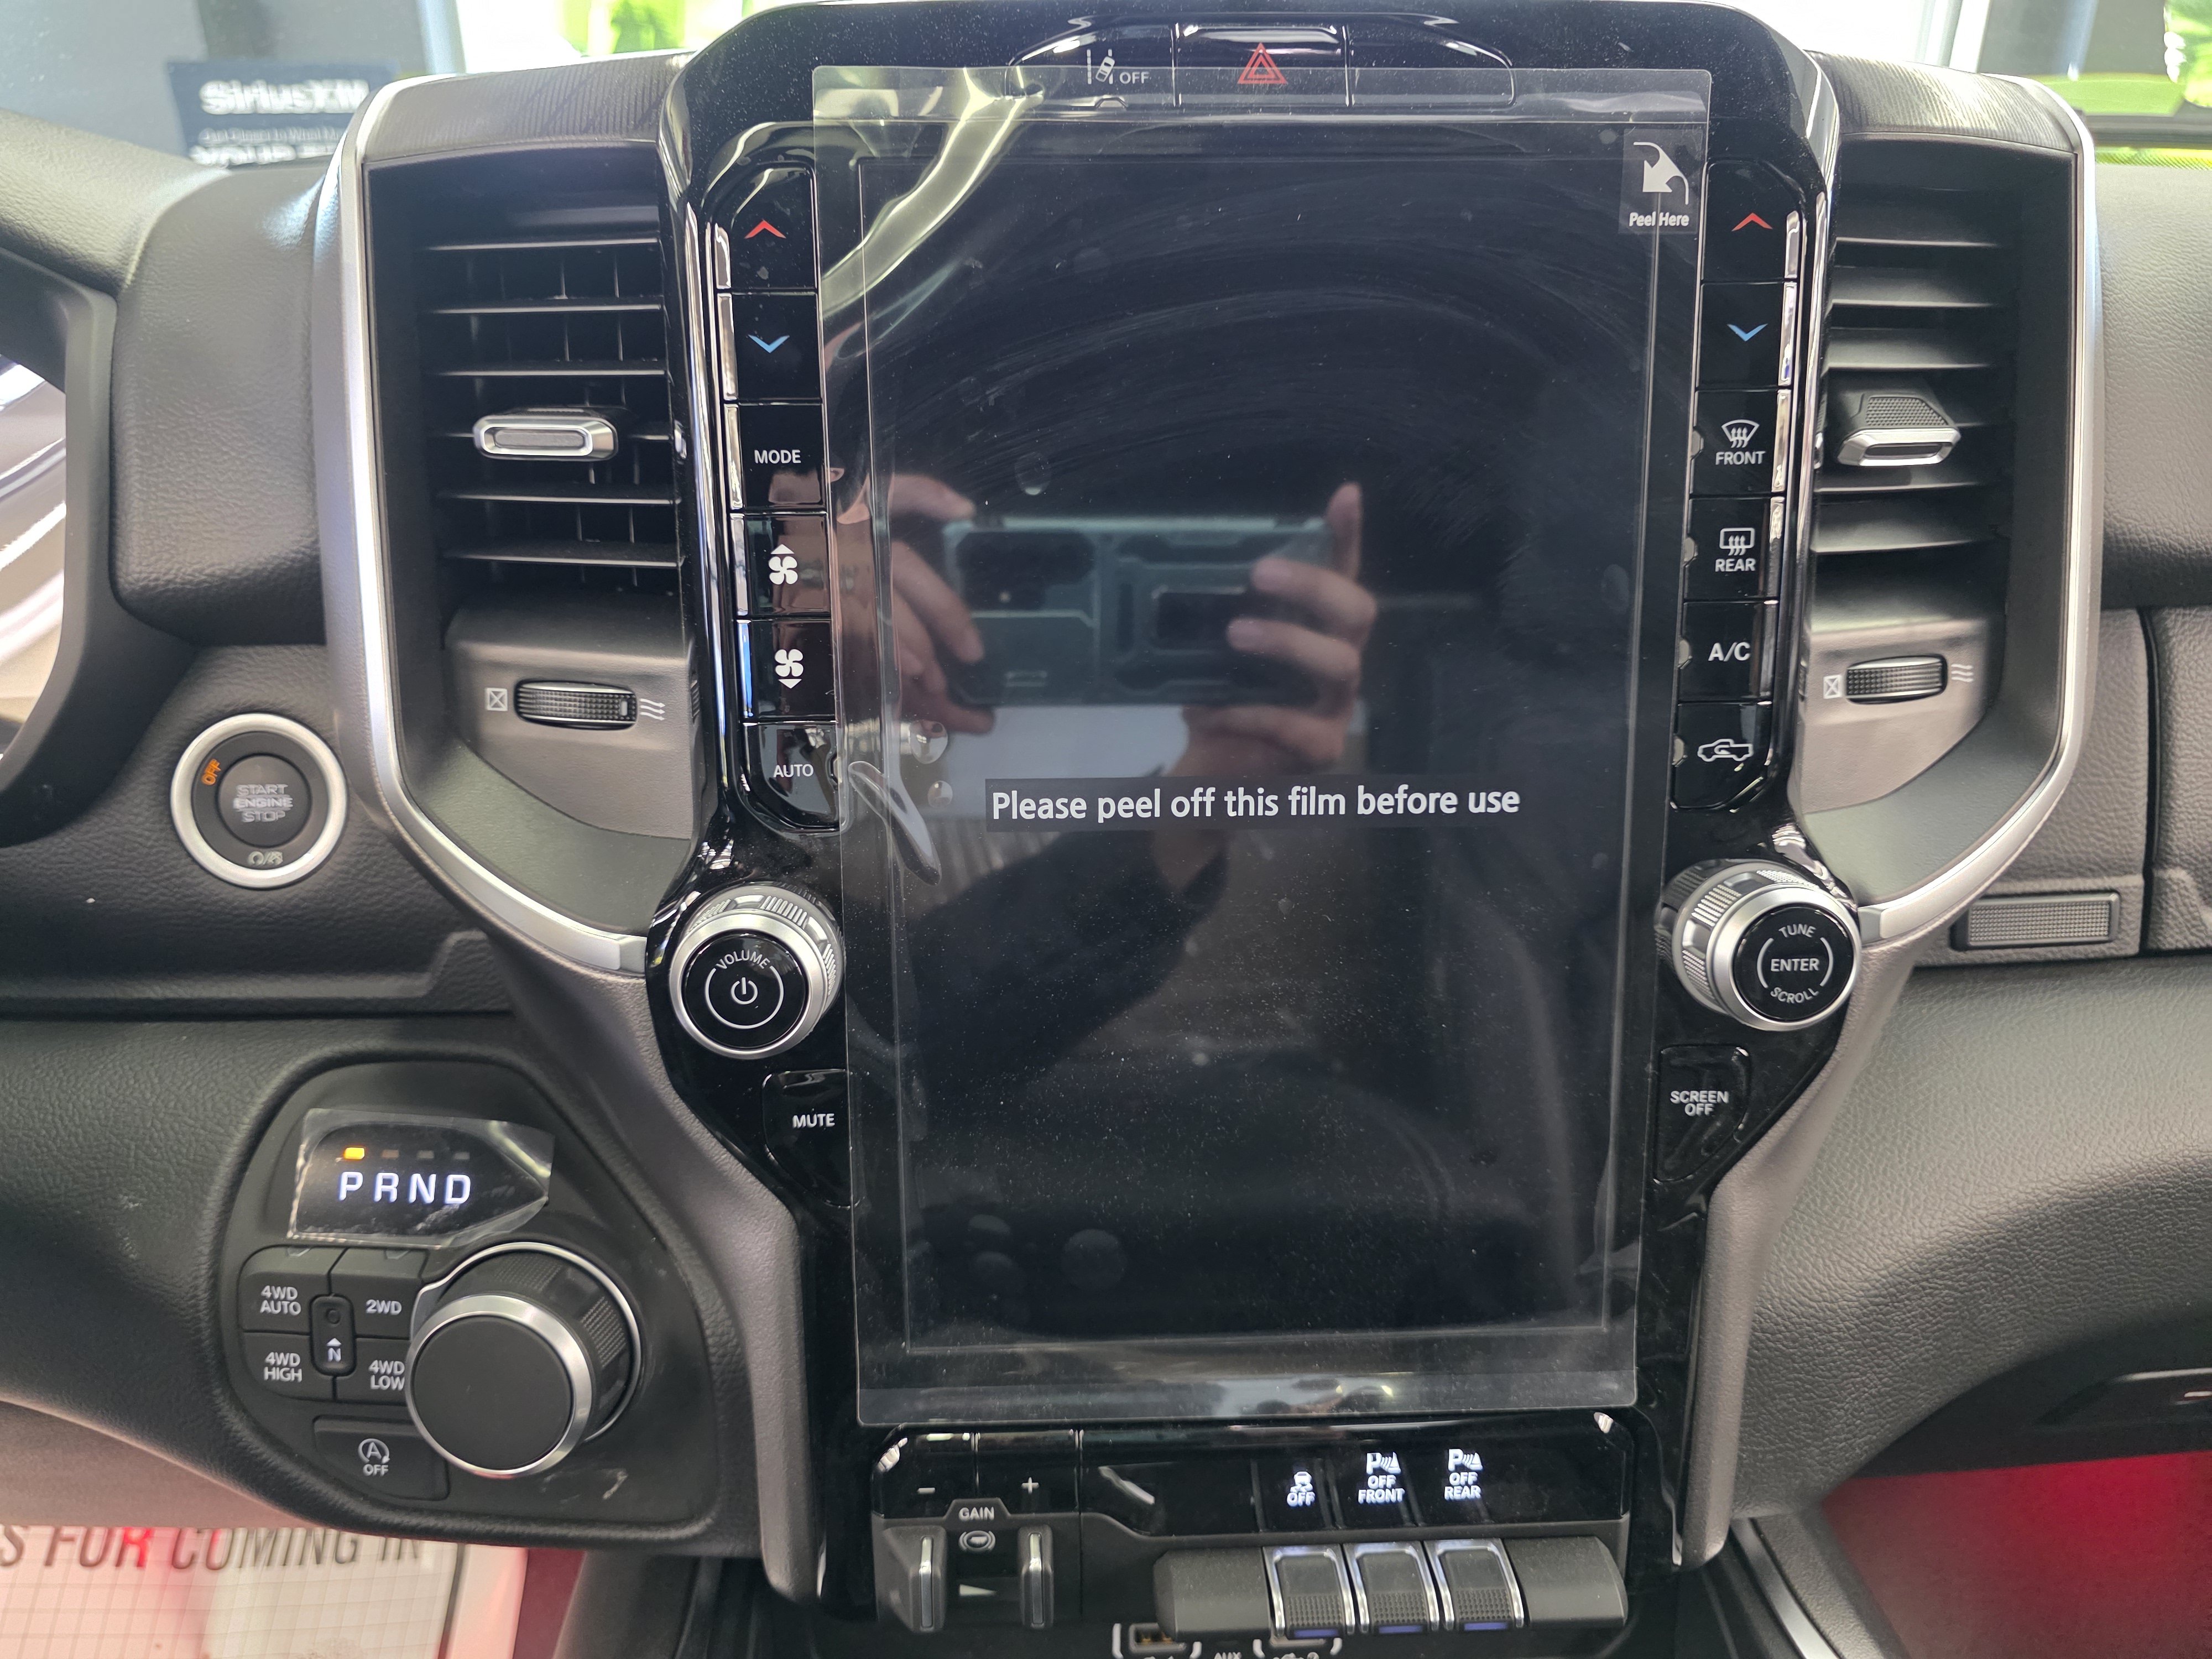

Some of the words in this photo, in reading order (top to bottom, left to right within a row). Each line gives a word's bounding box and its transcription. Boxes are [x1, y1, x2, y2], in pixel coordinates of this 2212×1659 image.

[1119, 71, 1150, 85] OFF
[1629, 211, 1656, 227] Peel
[1658, 212, 1689, 226] Here
[754, 450, 801, 464] MODE
[1715, 451, 1766, 465] FRONT
[1715, 558, 1756, 572] REAR
[1708, 641, 1751, 662] A/C
[201, 758, 221, 786] OFF
[773, 764, 814, 778] AUTO
[237, 784, 288, 796] START
[233, 797, 293, 810] ENGINE
[993, 790, 1087, 820] Please
[1098, 788, 1161, 823] peel
[1171, 787, 1215, 817] off
[1224, 787, 1279, 817] this
[1288, 785, 1345, 816] film
[1357, 784, 1458, 815] before
[1468, 791, 1520, 813] use
[241, 810, 286, 822] STOP
[1778, 924, 1816, 938] TUNE
[716, 949, 771, 969] VOLUME
[1770, 958, 1819, 972] ENTER
[1770, 987, 1819, 1004] SCROLL
[1670, 1090, 1729, 1104] SCREEN
[1684, 1103, 1714, 1116] OFF
[792, 1113, 835, 1128] MUTE
[260, 1285, 298, 1300] 4WD
[259, 1300, 301, 1316] AUTO
[366, 1299, 402, 1315] 2WD
[265, 1352, 301, 1366] 4WD
[327, 1348, 342, 1363] N
[264, 1366, 302, 1383] HIGH
[368, 1360, 405, 1375] 4WD
[370, 1375, 405, 1391] LOW
[363, 1463, 389, 1476] OFF
[1367, 1474, 1396, 1489] OFF
[1449, 1472, 1478, 1486] OFF
[1286, 1491, 1316, 1507] OFF
[1358, 1488, 1405, 1504] FRONT
[1444, 1485, 1481, 1500] REAR
[958, 1506, 995, 1521] GAIN
[44, 1527, 153, 1568] FOR
[170, 1528, 359, 1571] COMING
